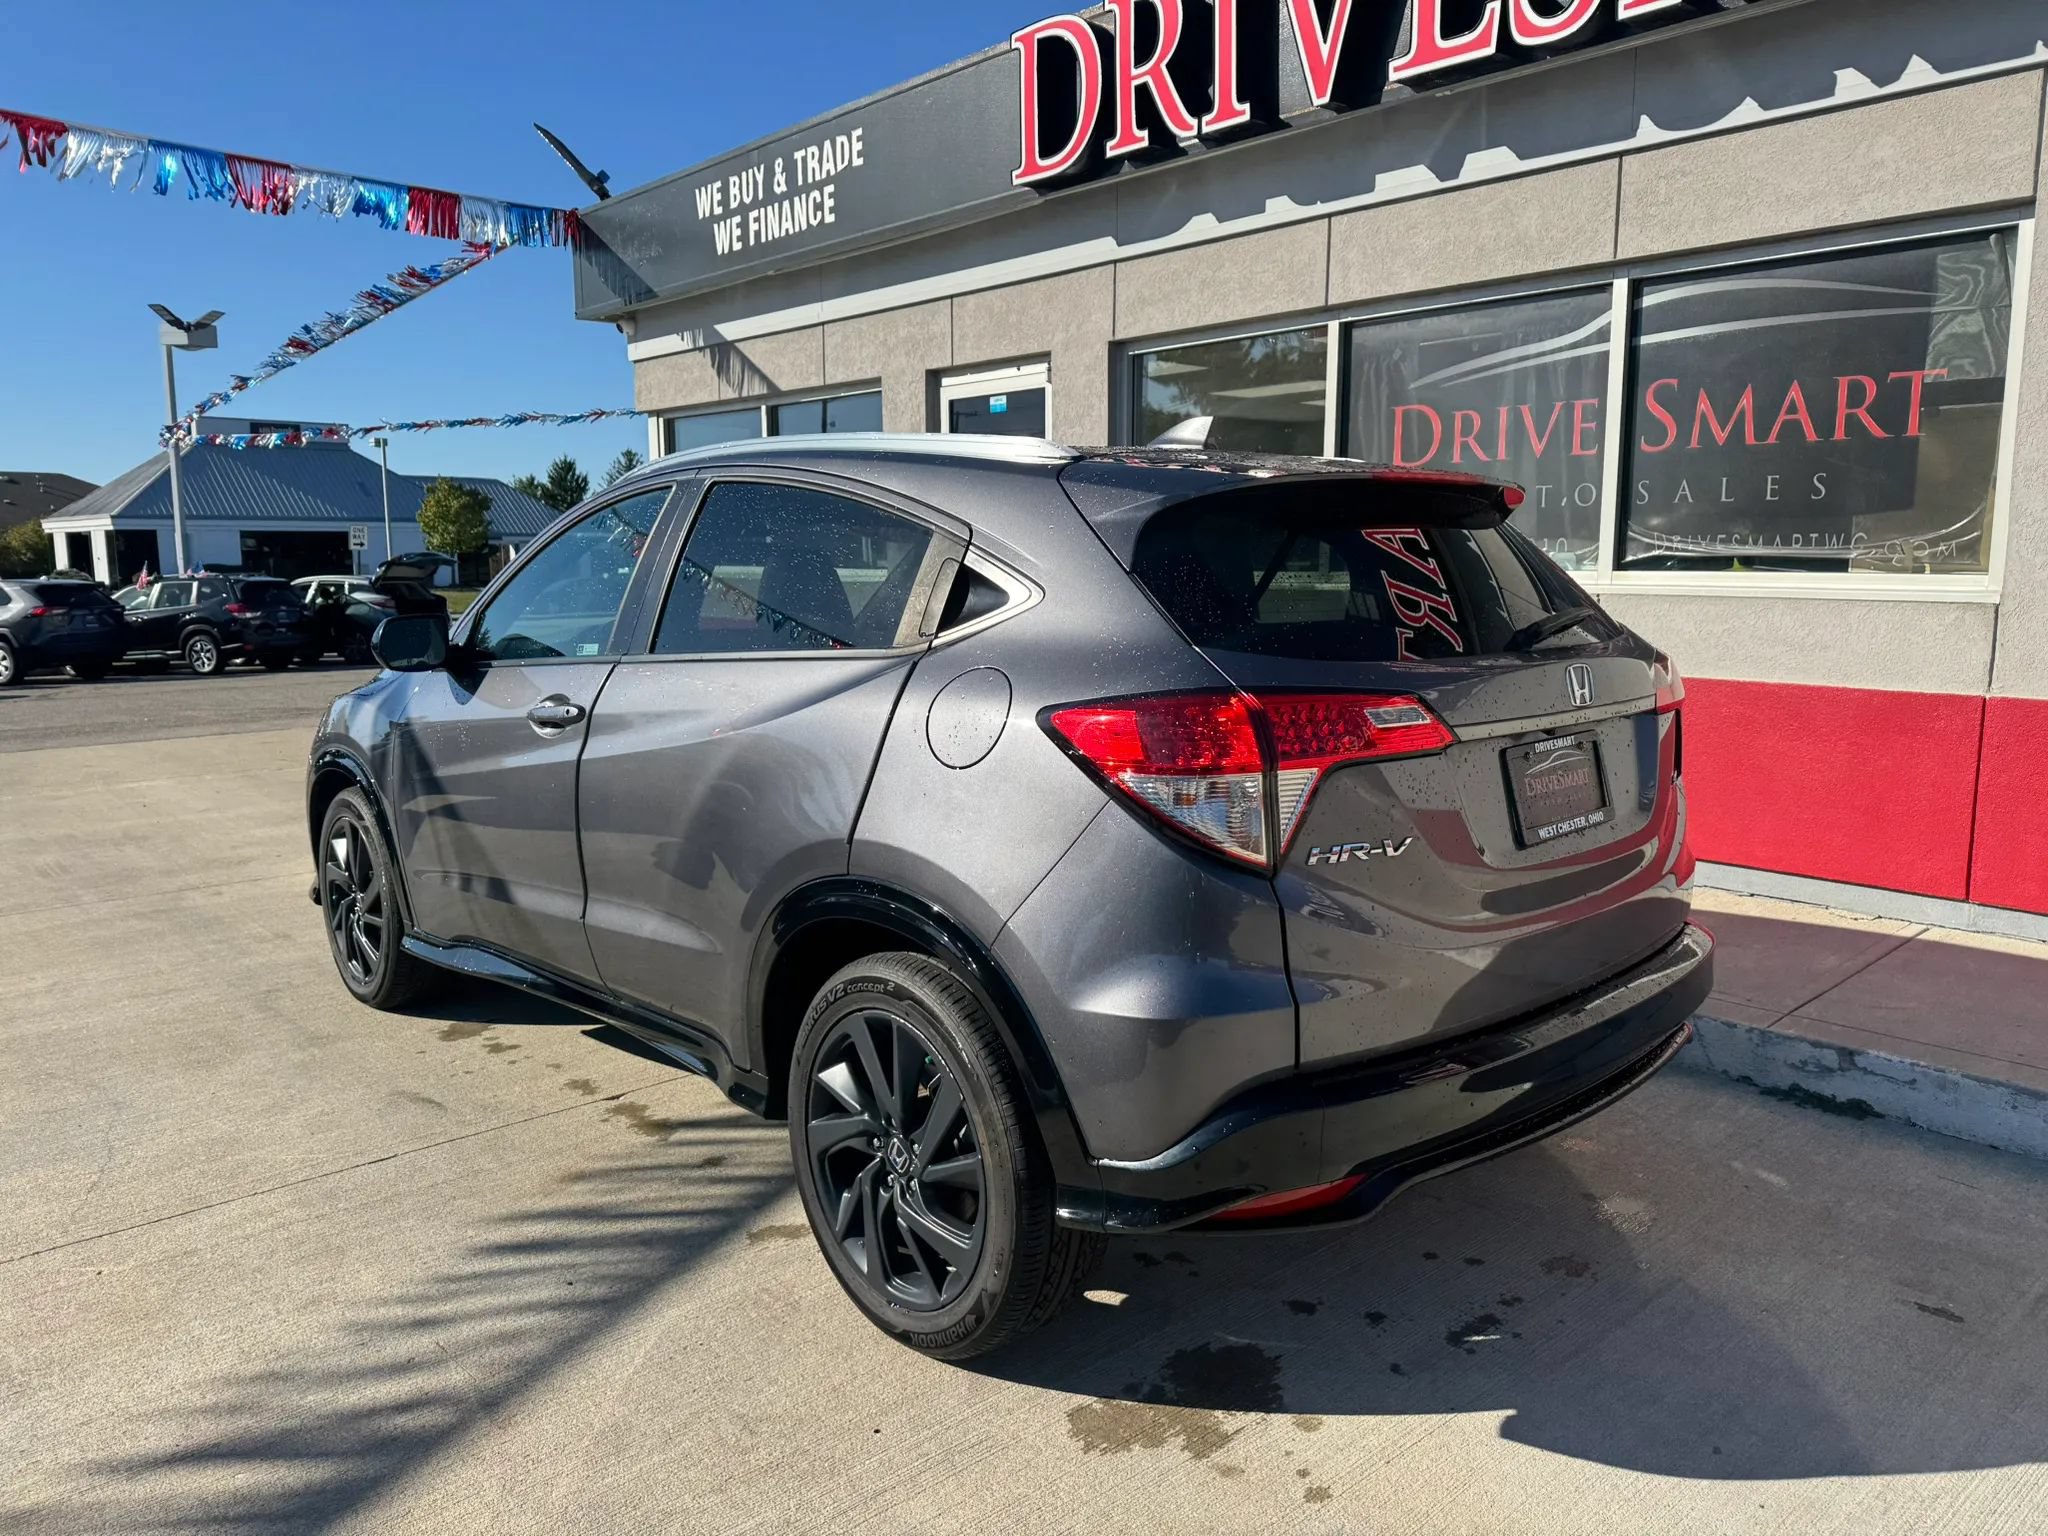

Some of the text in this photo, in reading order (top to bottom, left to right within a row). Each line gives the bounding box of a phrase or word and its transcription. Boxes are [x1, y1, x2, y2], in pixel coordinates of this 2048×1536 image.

[695, 127, 864, 219] WE BUY & TRADE
[713, 184, 836, 255] WE FINANCE
[1391, 367, 1949, 467] DRIVE SMART
[1636, 472, 1827, 505] SALES
[1534, 735, 1576, 754] DRIVESMART
[1538, 825, 1558, 840] WEST
[1558, 815, 1589, 834] CHESTER,
[1588, 811, 1604, 825] OHIO
[1307, 836, 1413, 866] HR-V
[847, 982, 884, 993] concept
